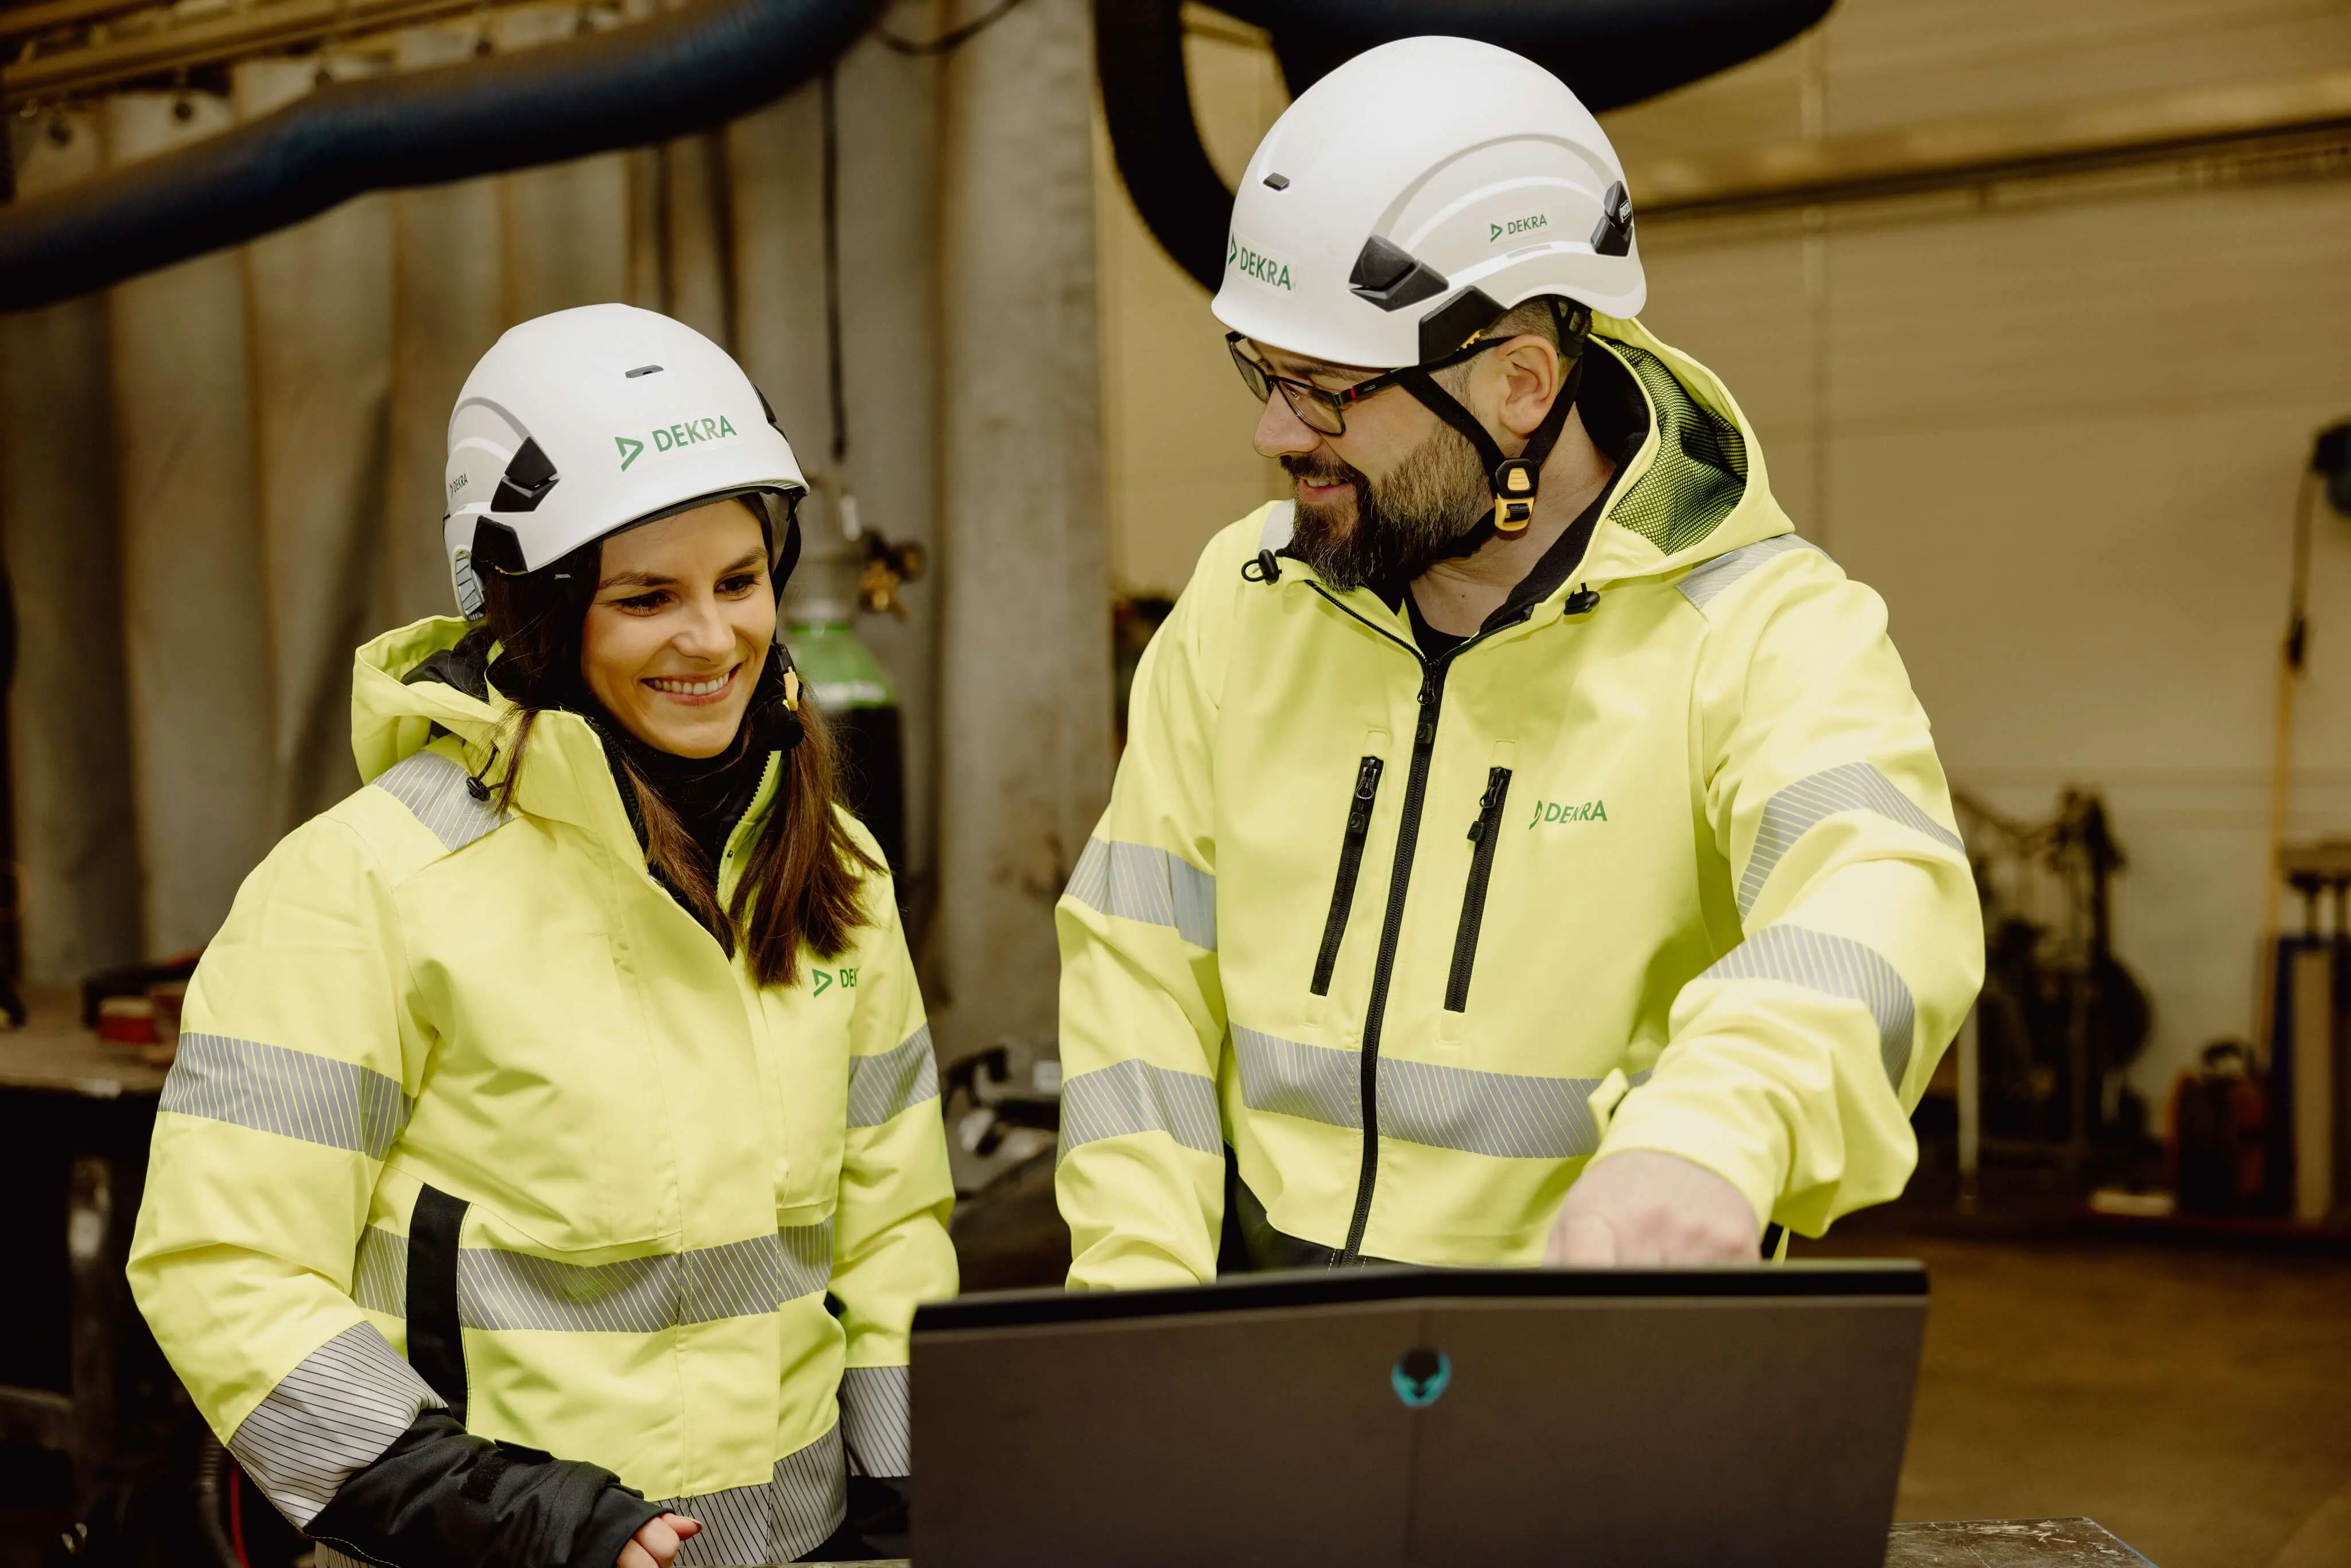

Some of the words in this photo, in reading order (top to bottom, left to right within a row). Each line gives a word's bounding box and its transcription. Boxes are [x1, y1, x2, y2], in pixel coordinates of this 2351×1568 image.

[1507, 214, 1547, 235] DEKRA
[1240, 246, 1291, 291] DEKRA
[651, 415, 738, 452] DEKRA
[453, 473, 468, 493] DEKRA
[1544, 799, 1607, 824] DEKRA
